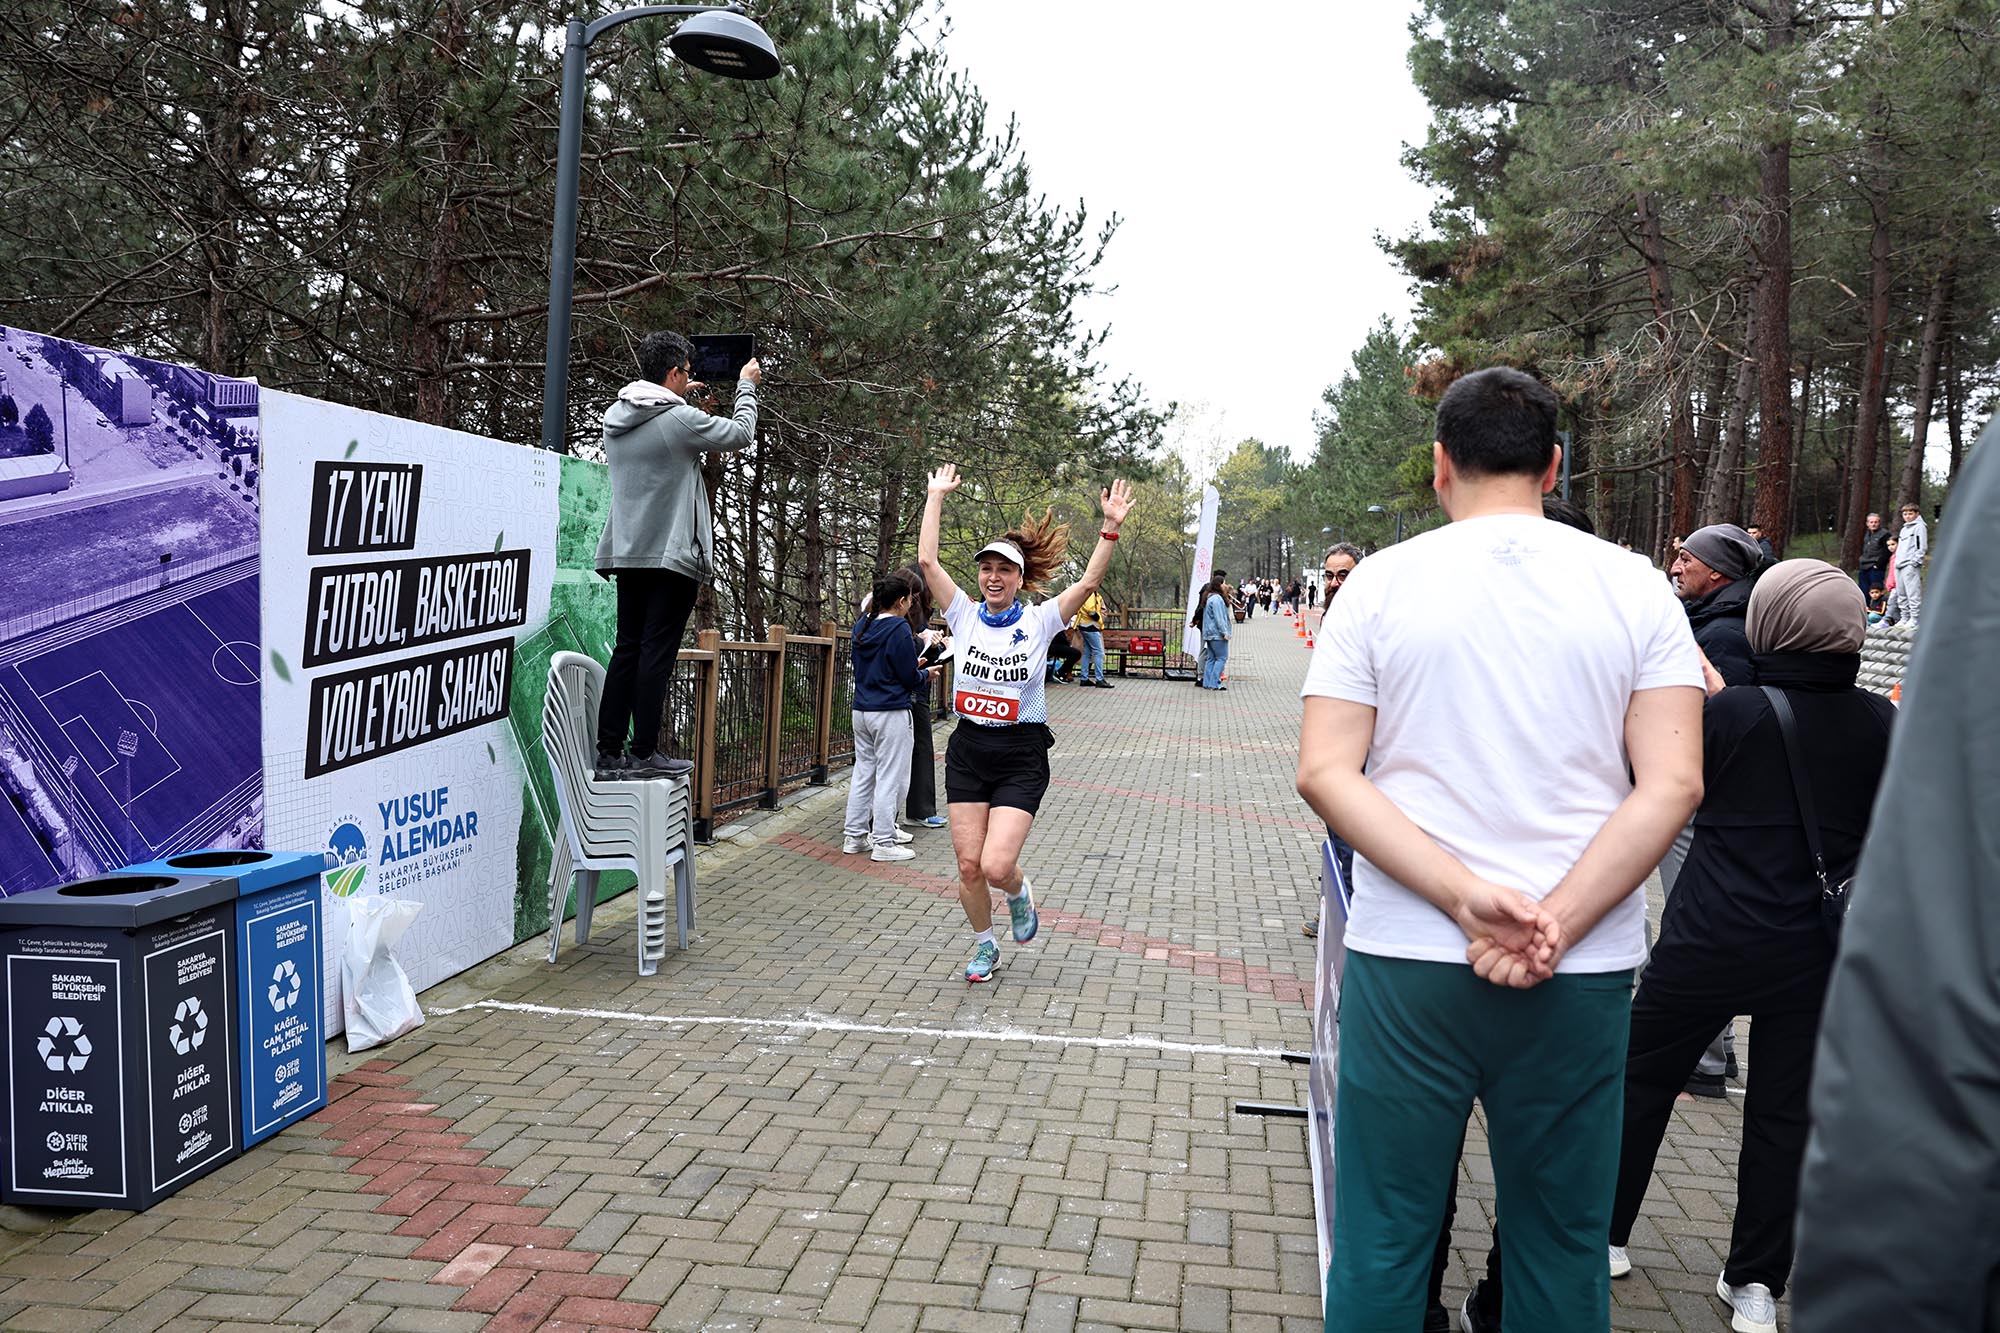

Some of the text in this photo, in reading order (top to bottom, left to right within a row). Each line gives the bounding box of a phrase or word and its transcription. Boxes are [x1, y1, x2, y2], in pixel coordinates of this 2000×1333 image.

[323, 470, 355, 548] 17
[358, 463, 413, 545] YENİ
[313, 558, 522, 656] FUTBOL, BASKETBOL,
[962, 661, 1029, 682] RUN CLUB
[319, 647, 508, 767] VOLEYBOL SAHASI
[964, 696, 1010, 717] 0750
[378, 786, 449, 830] YUSUF
[379, 810, 478, 866] ALEMDAR
[378, 843, 473, 883] SAKARYA BÜYÜKŞEHİR
[379, 859, 460, 895] BELEDİYE BAŞKANI
[276, 920, 300, 934] SAKARYA
[177, 952, 206, 968] SAKARYA
[177, 957, 216, 977] BÜYÜKŞEHİR
[51, 974, 93, 983] SAKARYA
[178, 966, 212, 985] BELEDİYESİ
[52, 982, 106, 993] BÜYÜKŞEHİR
[52, 991, 101, 1001] BELEDİYESİ
[274, 1015, 299, 1033] KAĞIT,
[263, 1022, 309, 1049] CAM, METAL
[271, 1035, 303, 1058] PLASTİK
[177, 1064, 205, 1085] DİĞER
[287, 1066, 300, 1078] ATIK
[46, 1087, 86, 1101] DİĞER
[172, 1073, 211, 1100] ATIKLAR
[39, 1101, 94, 1114] ATIKLAR
[192, 1104, 208, 1119] SIFIR
[193, 1112, 208, 1127] ATIK
[65, 1133, 88, 1143] SIFIR
[66, 1142, 88, 1151] ATIK
[42, 1164, 94, 1179] Hepimizin
